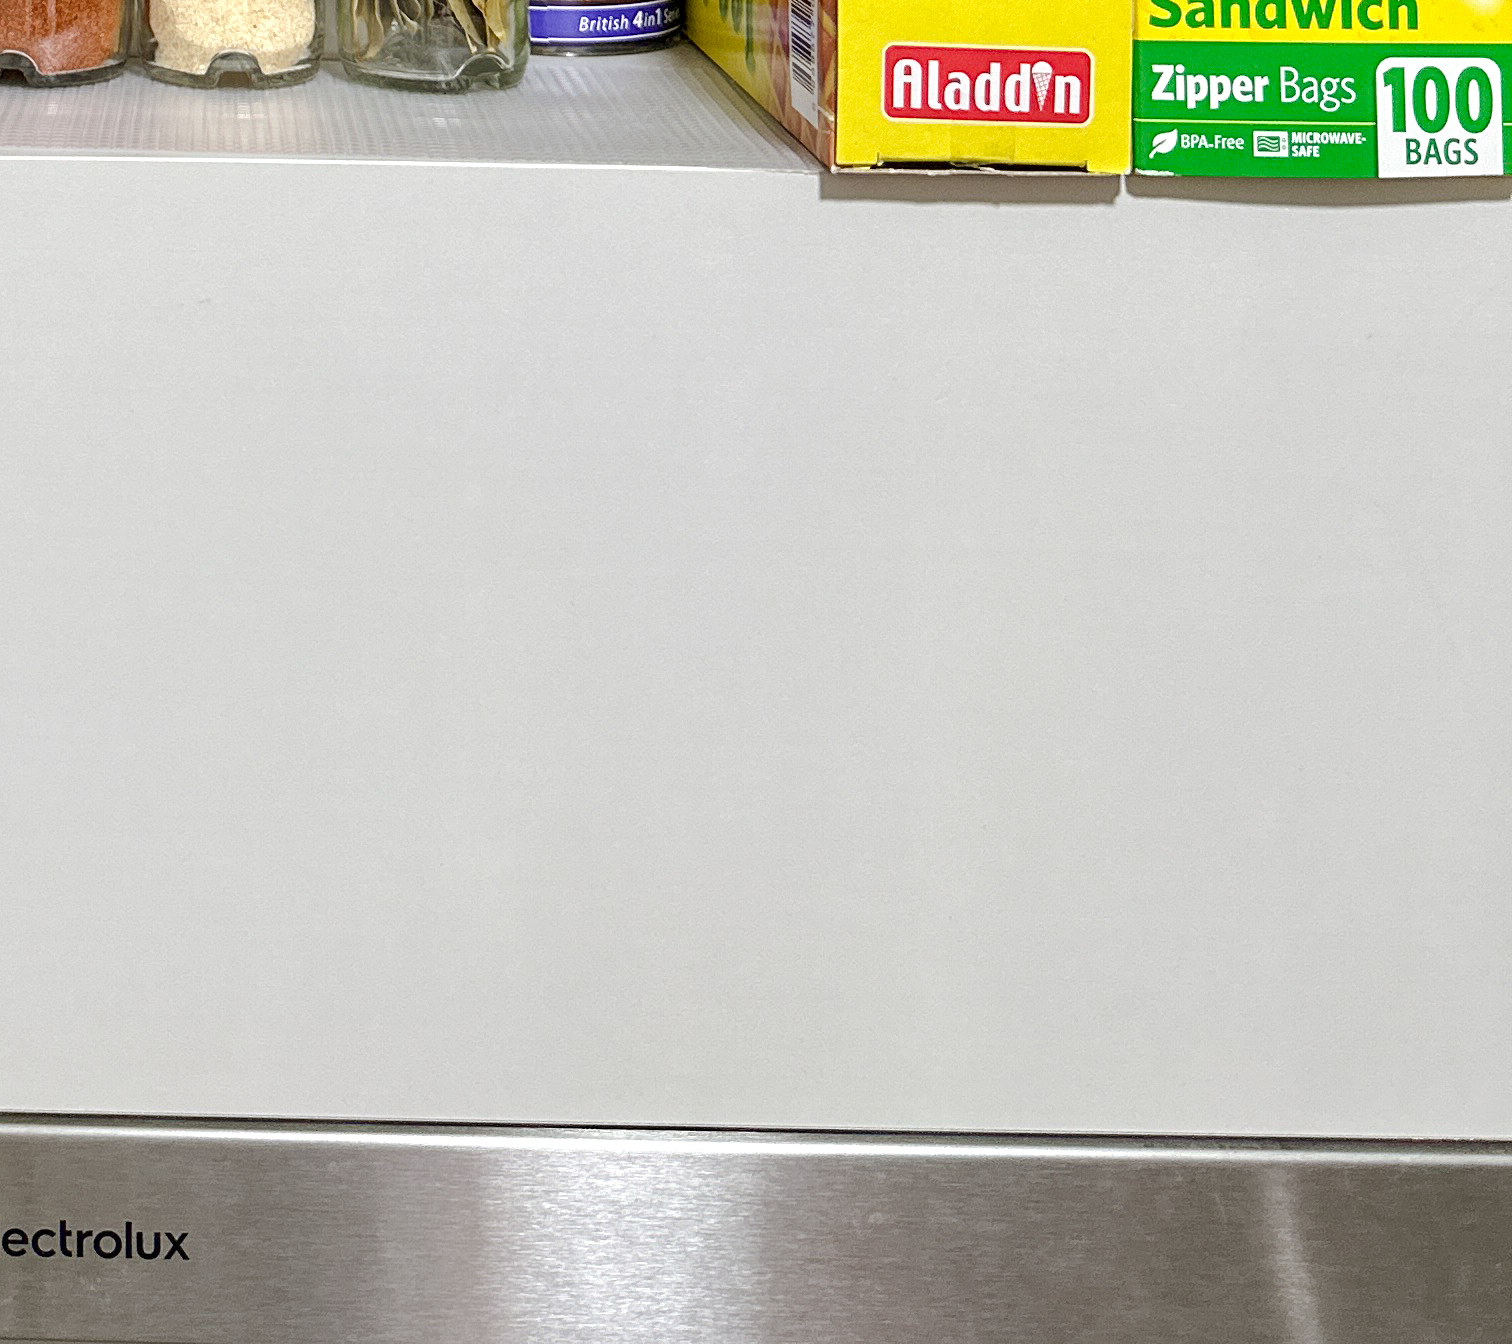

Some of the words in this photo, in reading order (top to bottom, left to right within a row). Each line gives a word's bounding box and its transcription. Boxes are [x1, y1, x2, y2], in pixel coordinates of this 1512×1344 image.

[579, 14, 629, 33] British
[633, 9, 663, 28] 4in1
[1151, 64, 1269, 109] Zipper
[1280, 66, 1357, 112] Bags
[1382, 66, 1493, 134] 100
[1180, 134, 1244, 149] BPA-Free
[1291, 131, 1366, 145] MICROWAVE-
[1292, 145, 1319, 158] SAFE
[1405, 138, 1478, 165] BAGS
